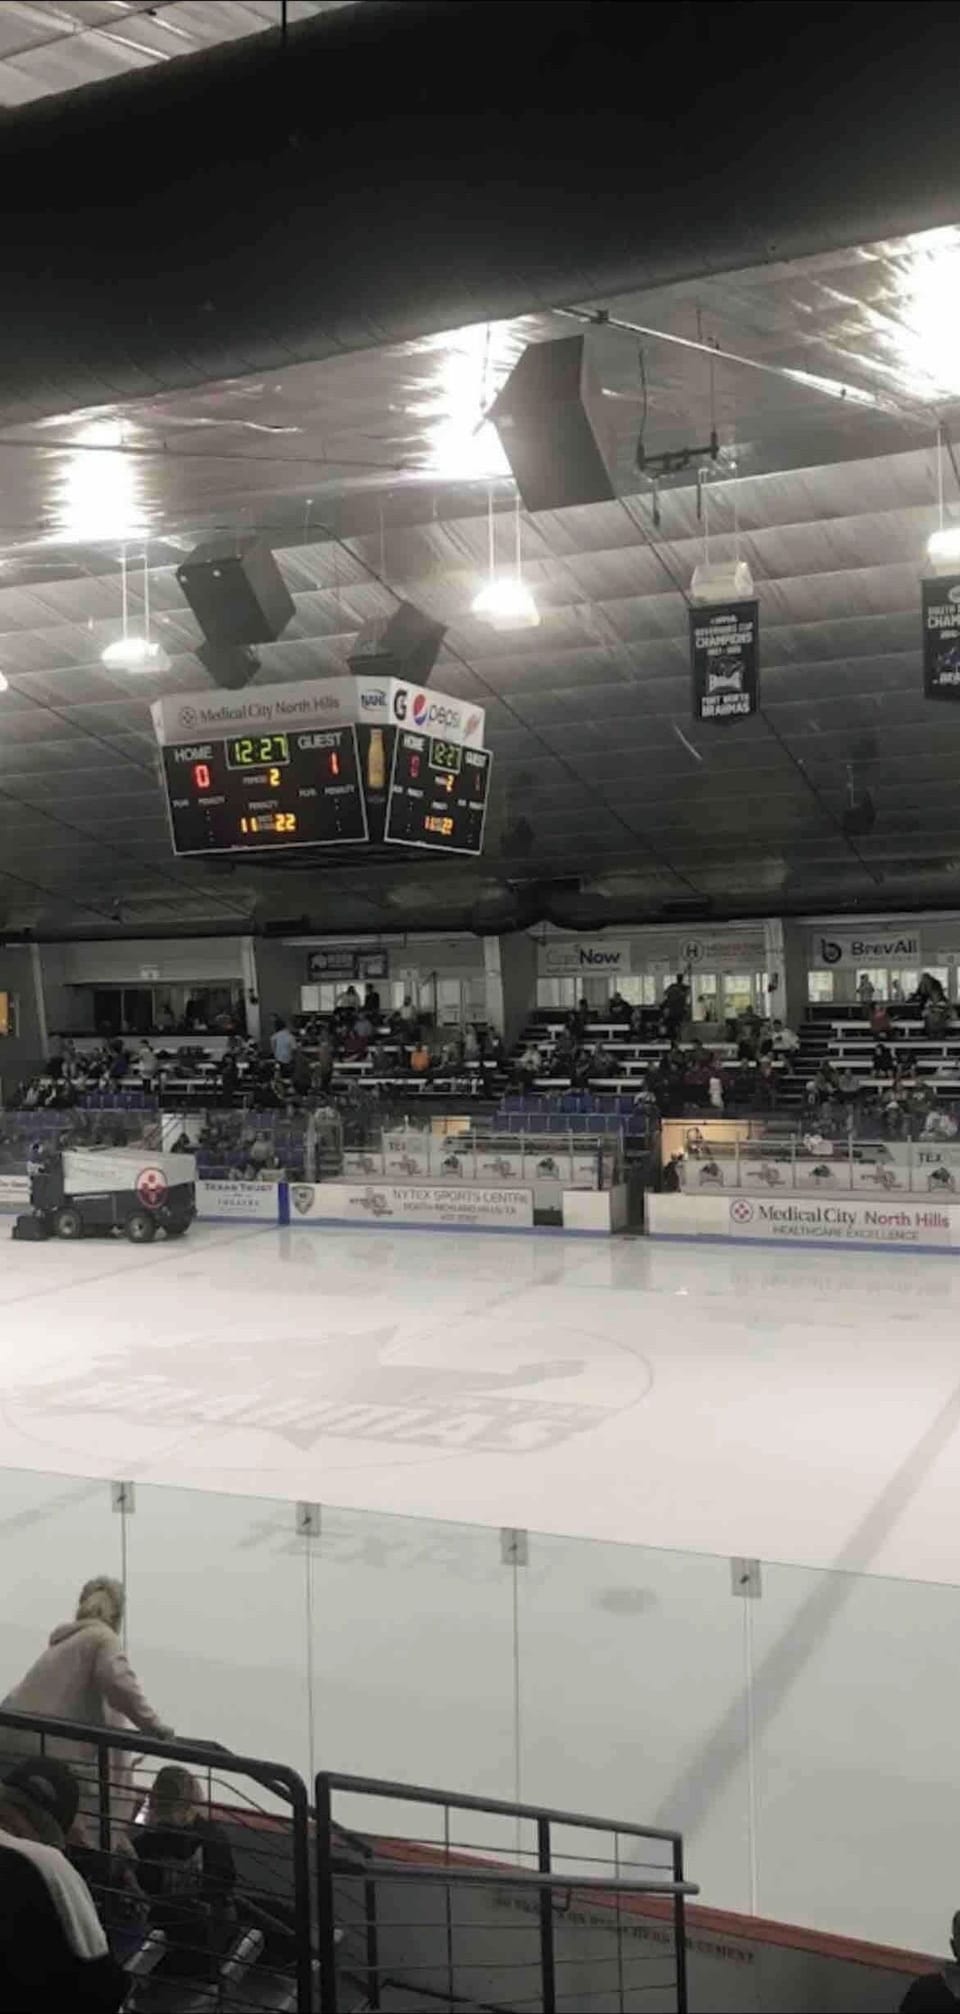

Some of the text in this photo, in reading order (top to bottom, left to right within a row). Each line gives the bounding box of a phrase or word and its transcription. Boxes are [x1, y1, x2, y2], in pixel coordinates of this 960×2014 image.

[696, 631, 752, 649] CHAMPIONS
[201, 696, 340, 723] Medical City North Hills
[429, 704, 460, 728] pepsi
[702, 702, 750, 717] BRAHMAS
[234, 736, 288, 764] 12:27
[297, 732, 343, 749] GUEST
[175, 745, 213, 763] HOME
[331, 752, 339, 775] 1
[194, 764, 211, 788] 0
[269, 767, 281, 787] 2
[275, 813, 297, 833] 22
[433, 1190, 480, 1202] SPORTS
[758, 1204, 950, 1229] Medical City North Hills
[773, 1225, 920, 1241] HEALTHCARE EXCELLENCE
